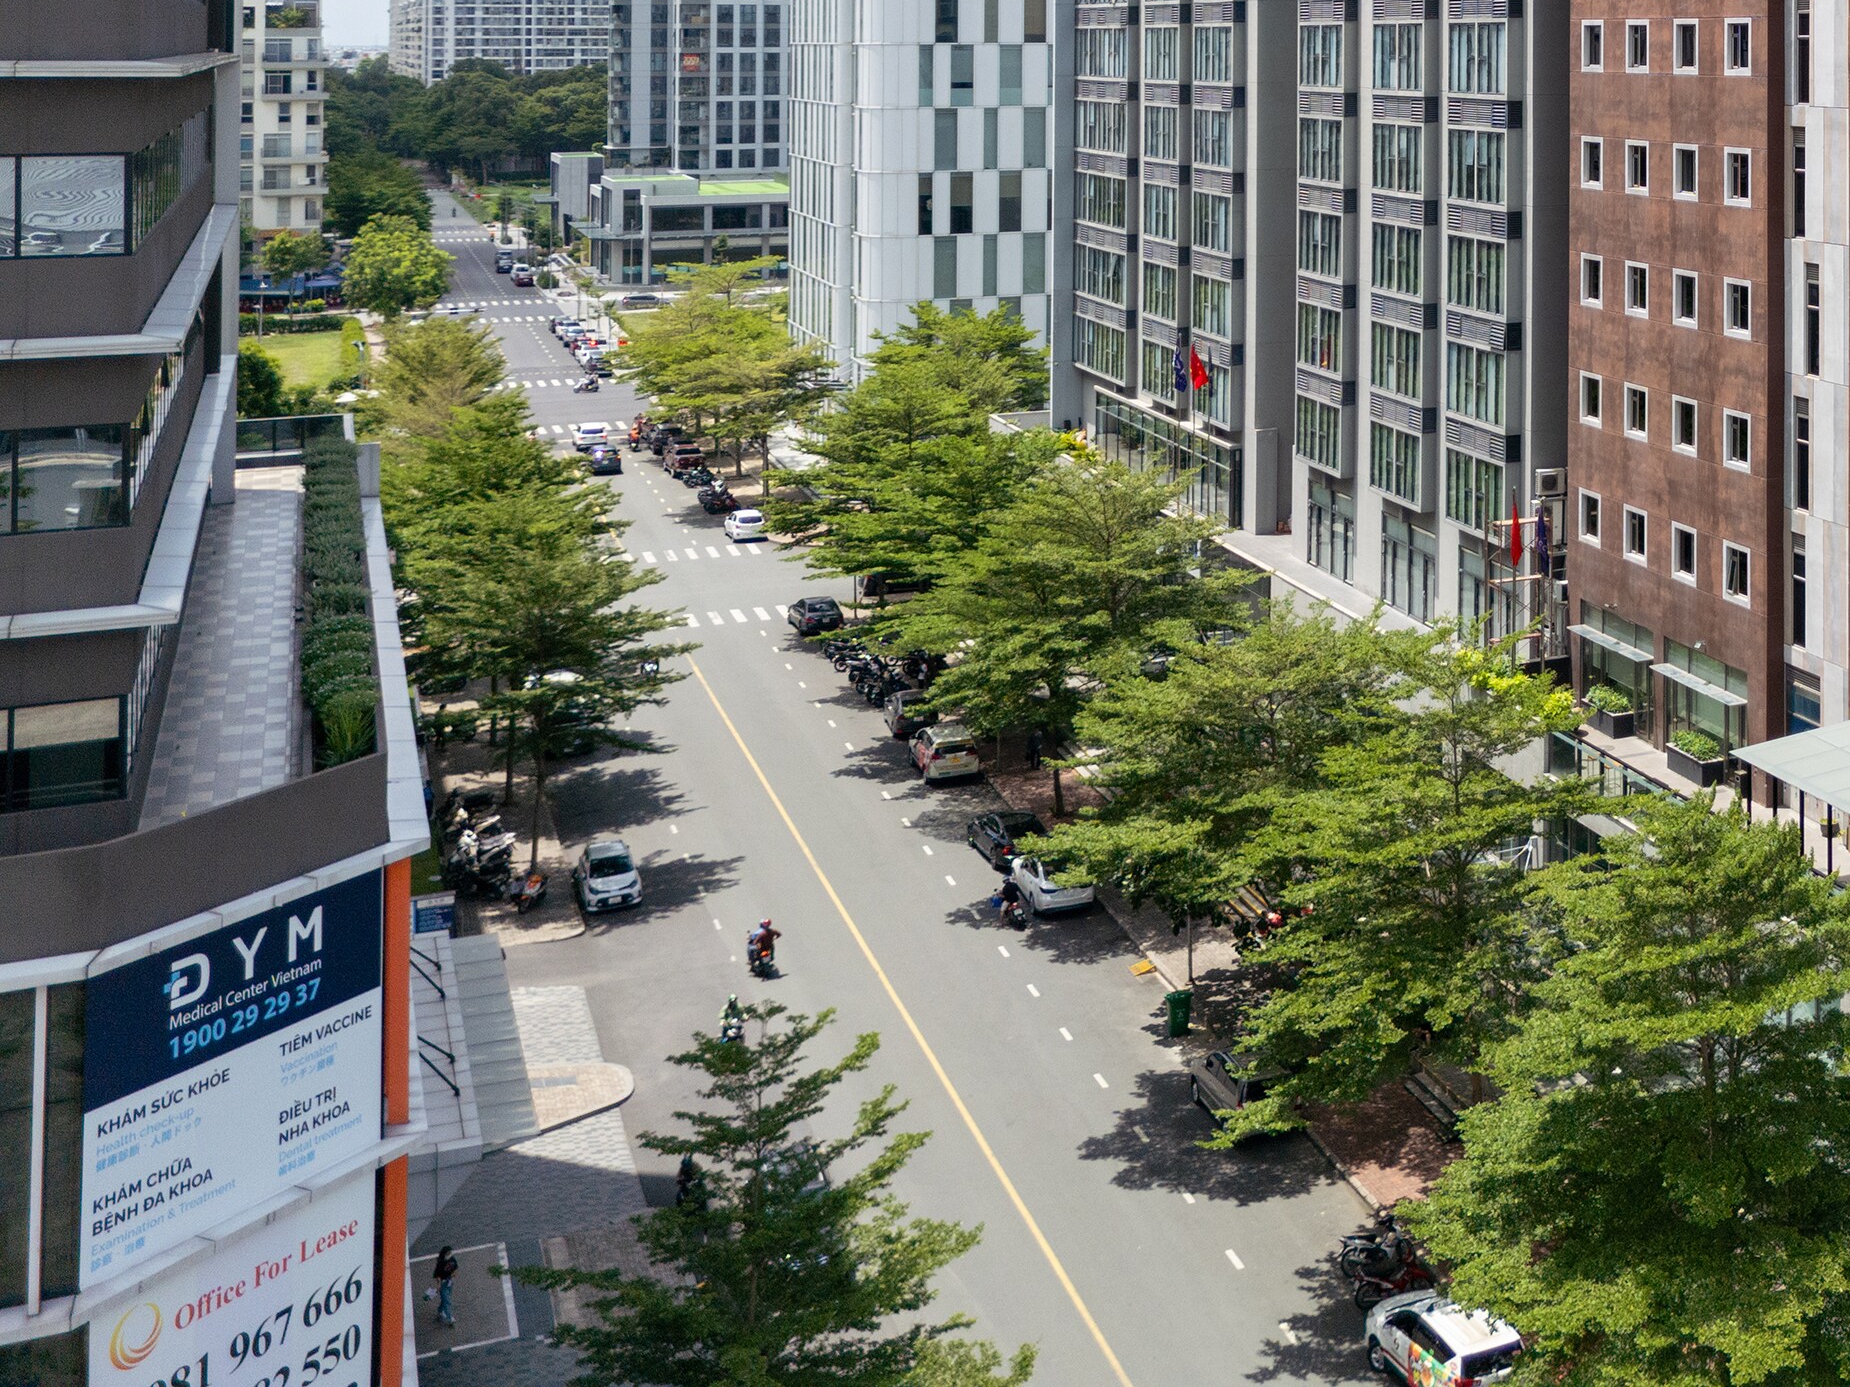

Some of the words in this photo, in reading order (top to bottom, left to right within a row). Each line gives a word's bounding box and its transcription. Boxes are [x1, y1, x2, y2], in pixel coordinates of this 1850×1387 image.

[168, 905, 323, 1010] DYM
[169, 995, 223, 1030] Medical
[225, 979, 268, 1006] Center
[272, 958, 322, 987] Vietnam
[170, 1018, 226, 1058] 1900
[231, 1004, 259, 1034] 29
[264, 991, 290, 1020] 29
[295, 977, 321, 1007] 37
[280, 1032, 312, 1056] TIÊM
[316, 1005, 372, 1040] VACCINE
[280, 1042, 338, 1073] Vaccination
[97, 1105, 146, 1138] KHÁM
[151, 1089, 184, 1114] SỨC
[279, 1121, 309, 1145] NHA
[312, 1100, 350, 1129] KHOA
[315, 1086, 336, 1107] TRỊ
[96, 1131, 136, 1157] Health
[140, 1107, 194, 1138] check-up
[279, 1138, 312, 1162] Dental
[314, 1114, 362, 1145] treatment
[92, 1203, 138, 1237] BỆNH
[143, 1192, 165, 1212] ĐA
[169, 1168, 213, 1200] KHOA
[93, 1179, 142, 1214] KHÁM
[146, 1157, 192, 1188] CHỮA
[91, 1214, 165, 1256] Examination
[167, 1208, 176, 1220] &
[179, 1179, 236, 1213] Treatment
[174, 1280, 246, 1330] Office
[253, 1254, 292, 1288] For
[300, 1219, 358, 1263] Lease
[150, 1352, 213, 1387] 81
[229, 1304, 294, 1375] 967
[303, 1264, 363, 1327] 666
[302, 1324, 361, 1387] 550
